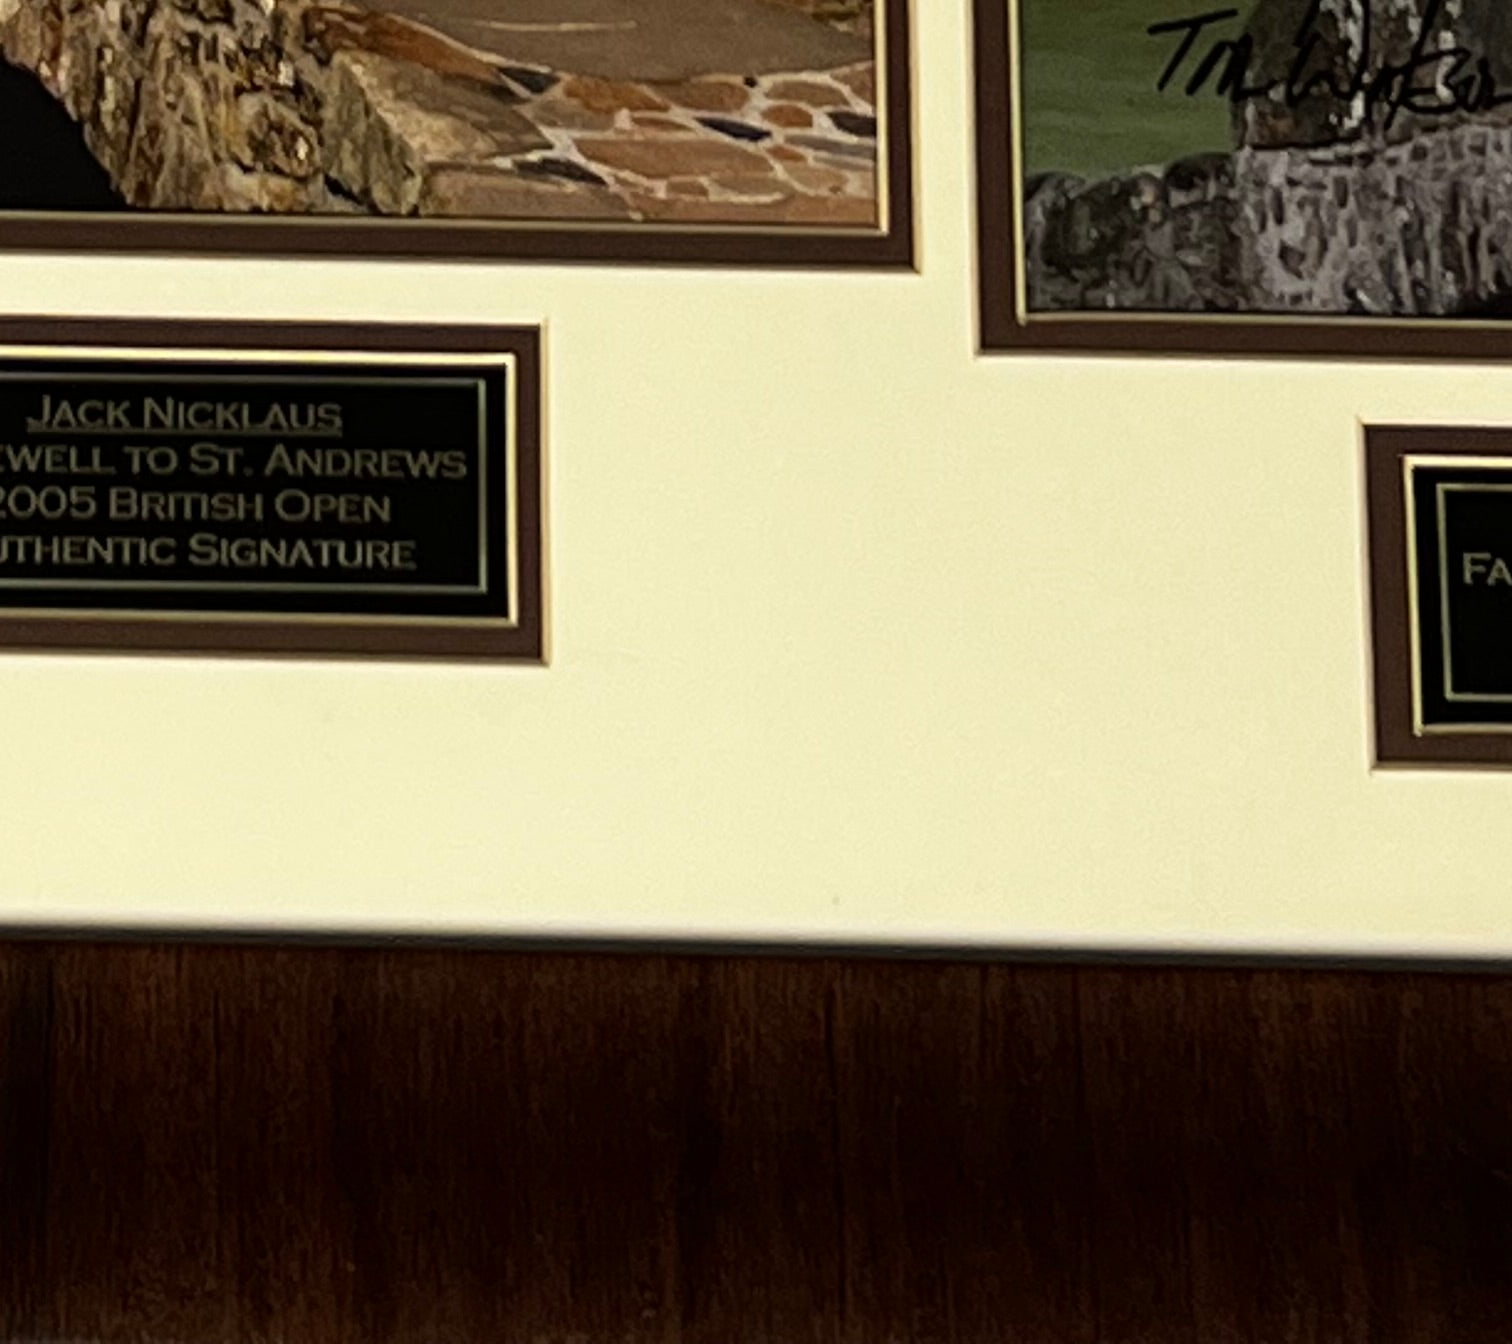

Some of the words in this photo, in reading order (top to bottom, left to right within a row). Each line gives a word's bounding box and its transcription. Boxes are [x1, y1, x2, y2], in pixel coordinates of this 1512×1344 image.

[26, 394, 131, 431] JACK
[142, 396, 343, 433] NICKLAUS
[123, 445, 179, 476] TO
[263, 442, 468, 479] ANDREWS
[108, 486, 264, 521] BRITISH
[273, 488, 391, 523] OPEN
[187, 532, 416, 570] SIGNATURE
